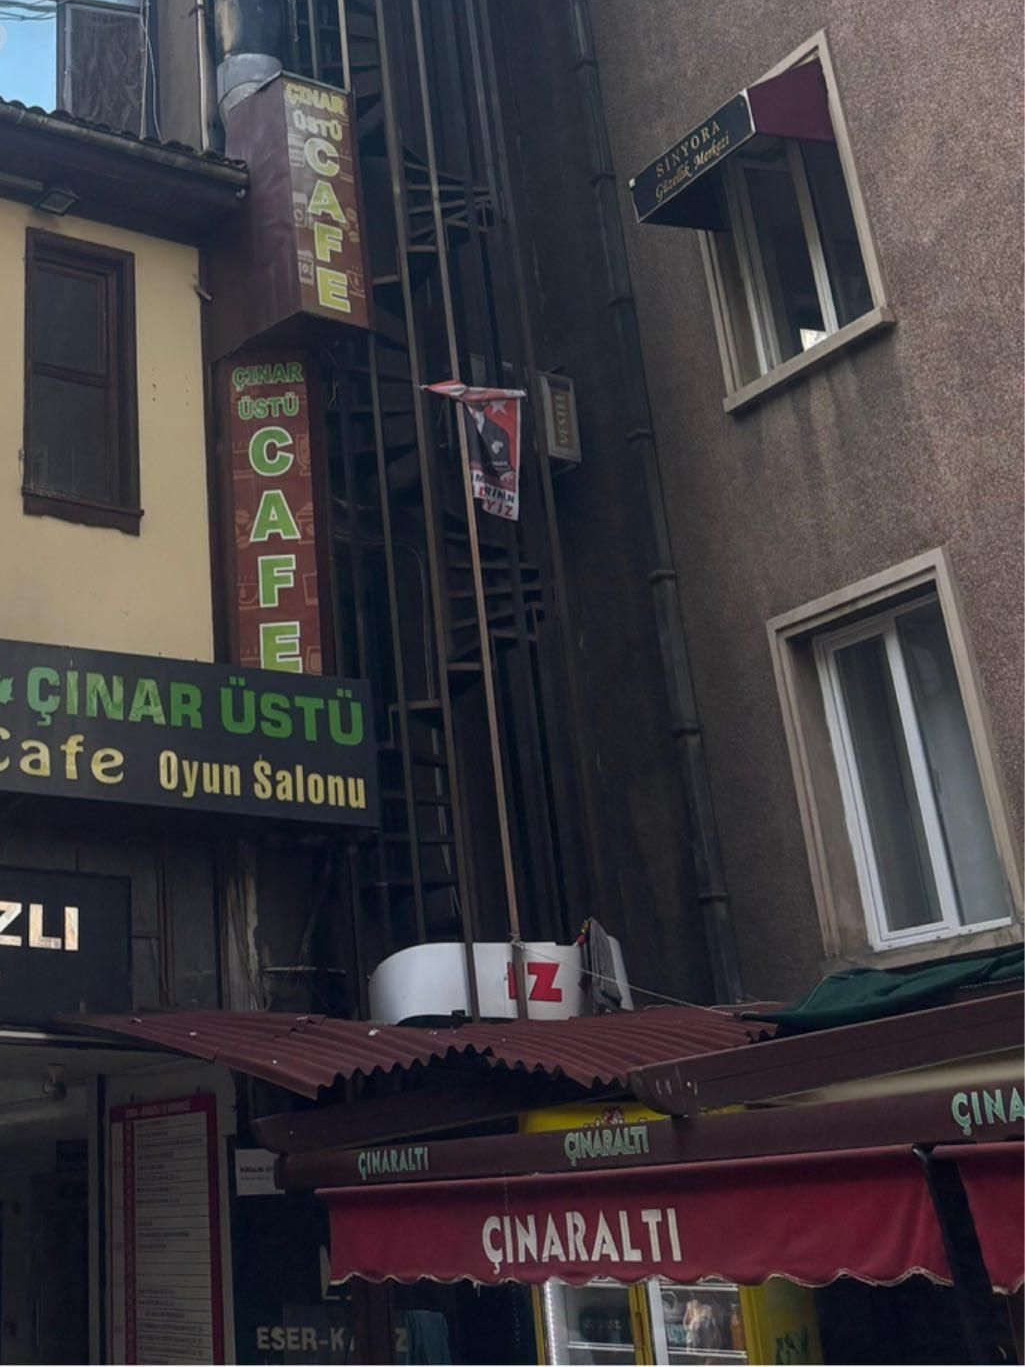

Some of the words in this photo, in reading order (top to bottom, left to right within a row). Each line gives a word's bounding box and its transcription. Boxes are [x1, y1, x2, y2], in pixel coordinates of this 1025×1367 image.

[285, 82, 347, 115] ÇINAR
[293, 109, 344, 141] ÜSTÜ
[693, 131, 730, 171] Merkezi
[303, 137, 352, 314] CAFE
[232, 362, 304, 391] ÇINAR
[237, 391, 299, 420] ÜSTÜ
[248, 426, 302, 676] CAFE
[27, 664, 203, 727] ÇINAR
[221, 676, 364, 746] ÜSTÜ
[159, 749, 241, 799] Oyun
[253, 758, 367, 809] Salonu
[357, 1146, 429, 1181] ÇINARALTI
[564, 1125, 650, 1167] ÇINARALTI
[482, 1207, 683, 1274] ÇINARALTI
